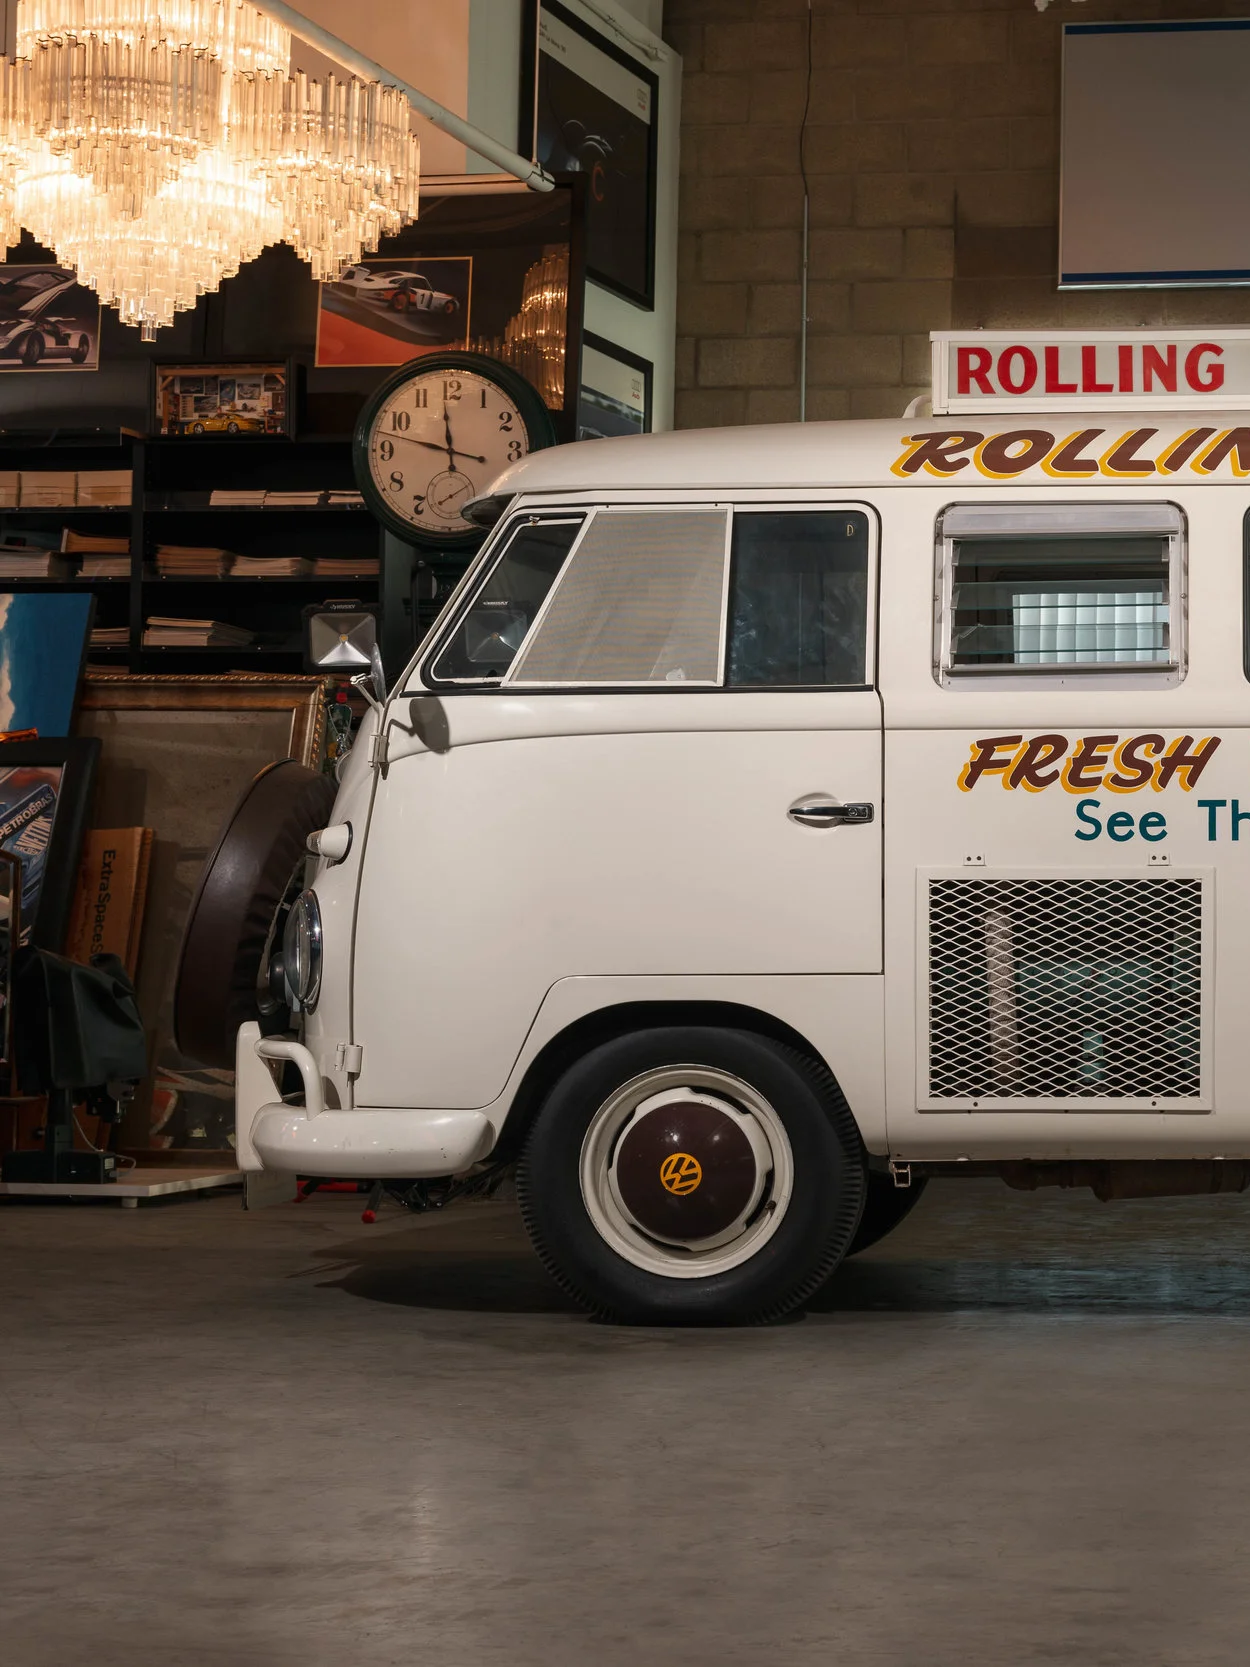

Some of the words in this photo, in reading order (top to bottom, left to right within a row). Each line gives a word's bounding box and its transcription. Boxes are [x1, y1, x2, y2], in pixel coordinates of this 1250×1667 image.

[957, 343, 1225, 395] ROLLING
[415, 388, 428, 408] 11
[442, 380, 462, 401] 12
[479, 389, 487, 409] 1
[391, 411, 411, 432] 10
[498, 411, 513, 433] 2
[380, 439, 394, 462] 9
[507, 440, 522, 463] 3
[389, 471, 405, 493] 8
[413, 494, 426, 516] 7
[957, 734, 1222, 795] FRESH
[1074, 798, 1168, 842] See
